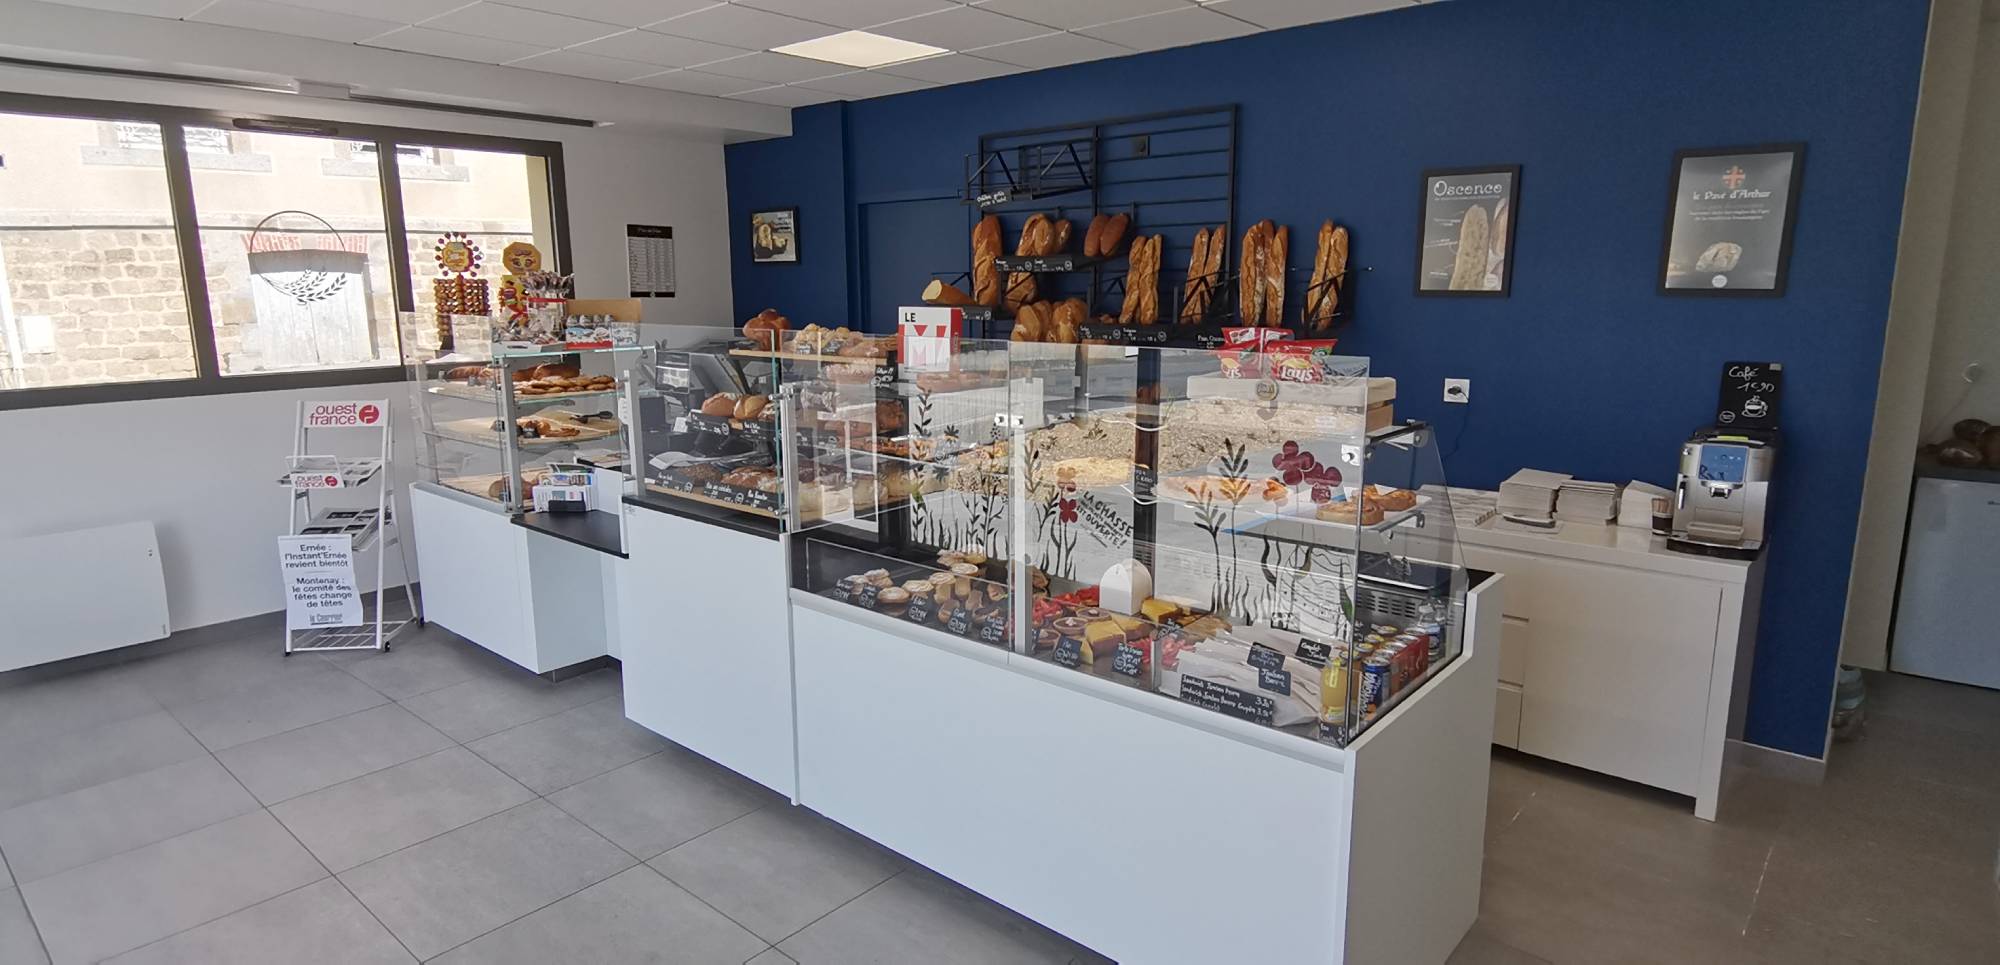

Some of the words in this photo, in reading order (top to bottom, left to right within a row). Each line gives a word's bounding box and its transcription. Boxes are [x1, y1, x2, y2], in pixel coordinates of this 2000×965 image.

[1433, 180, 1503, 196] Oscence
[904, 312, 916, 322] LE
[1728, 365, 1759, 381] Café
[316, 403, 357, 415] ouest
[310, 413, 357, 425] france
[1083, 490, 1095, 503] LA
[1095, 501, 1134, 537] CHASSE
[303, 584, 334, 592] comité
[320, 592, 352, 600] change
